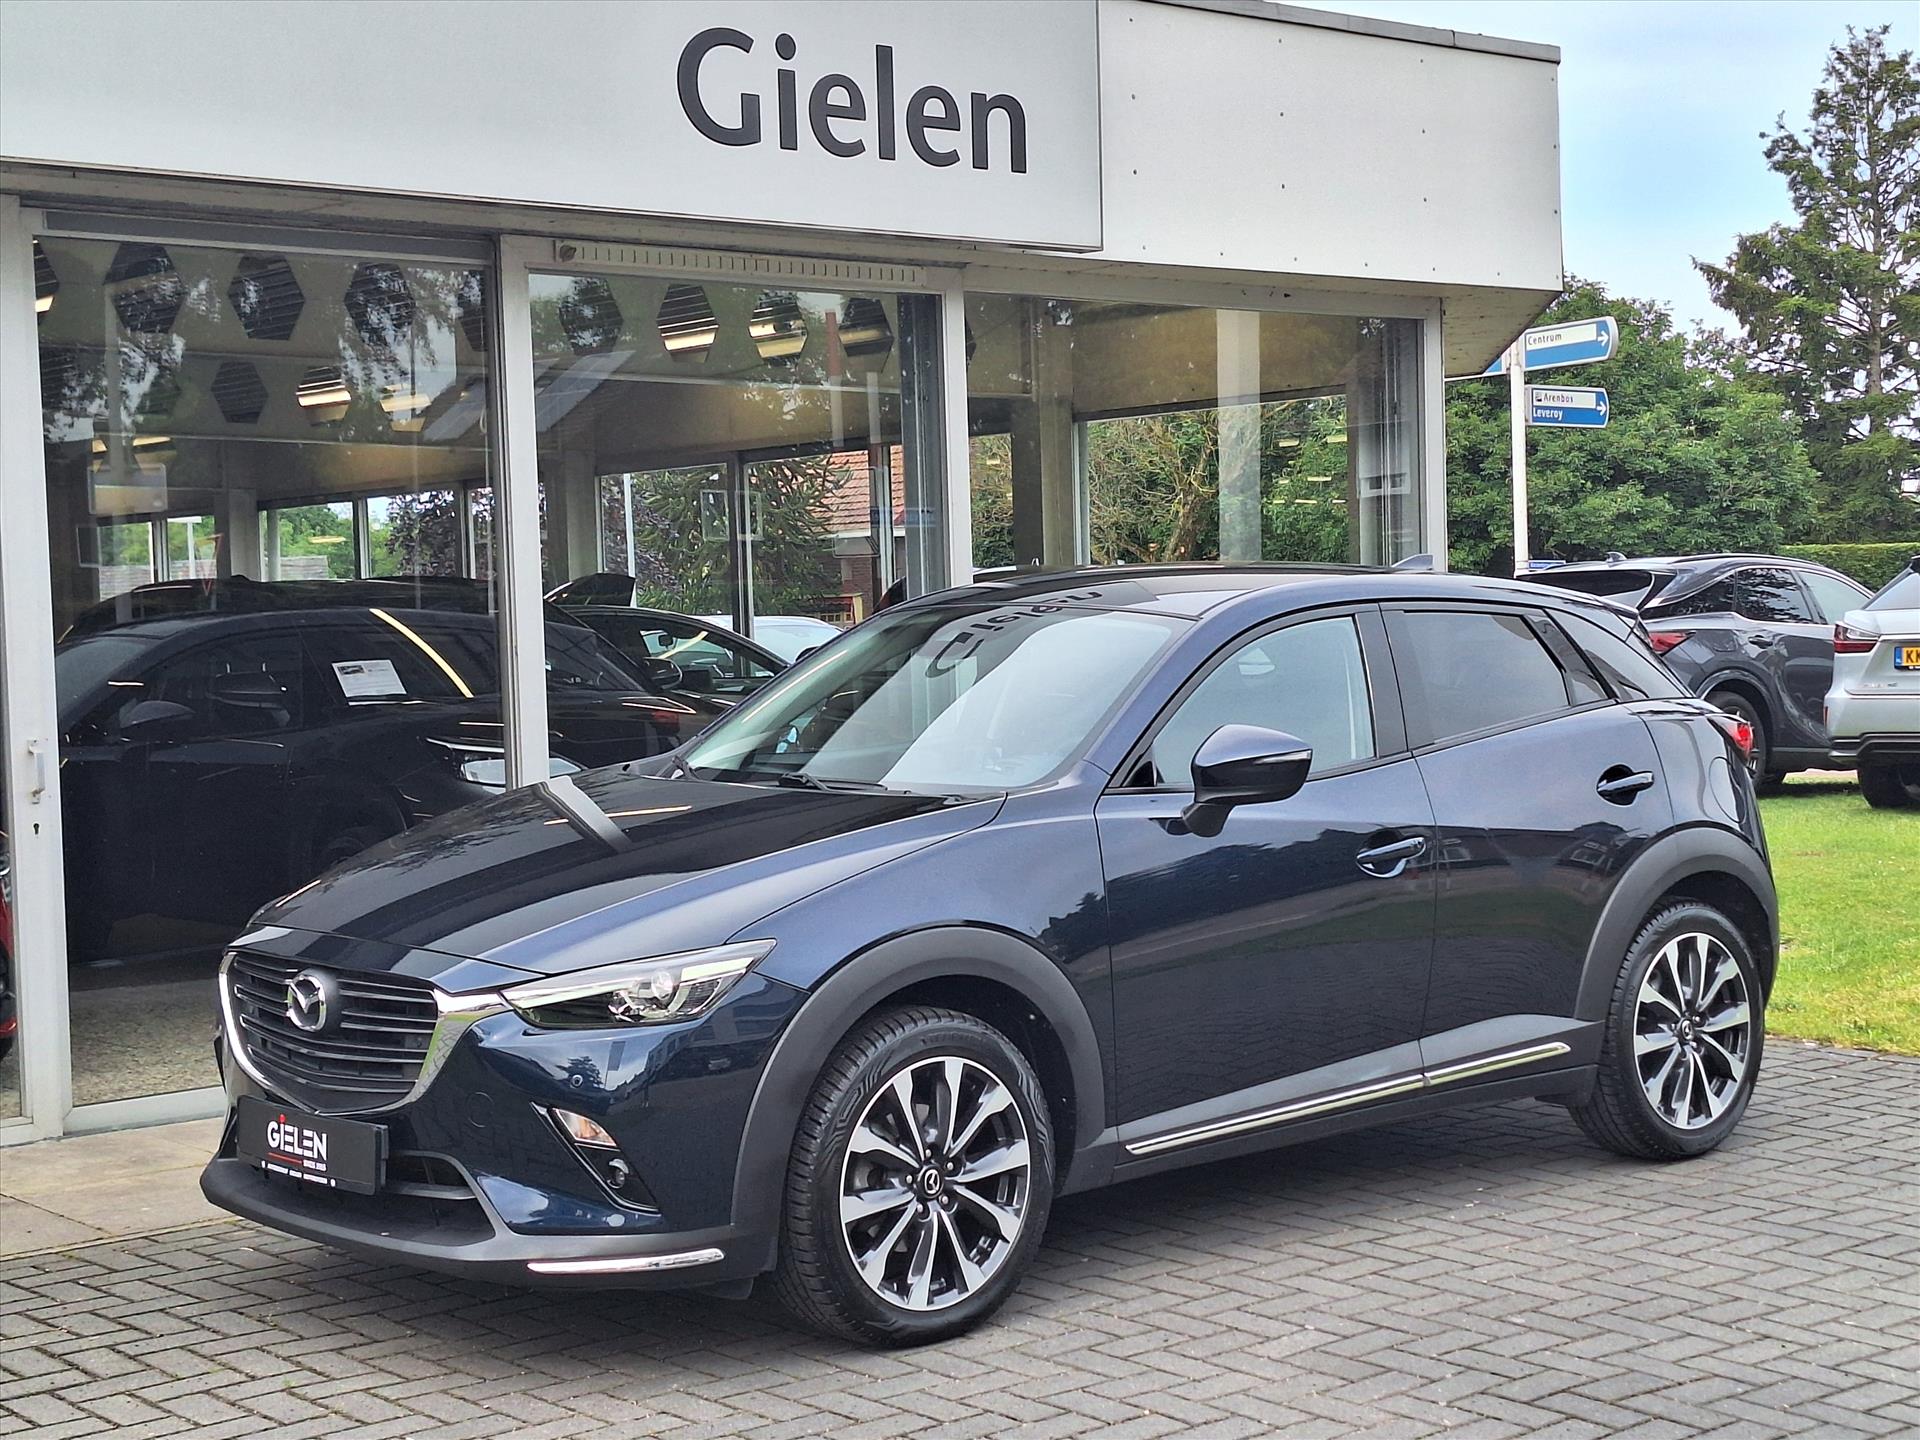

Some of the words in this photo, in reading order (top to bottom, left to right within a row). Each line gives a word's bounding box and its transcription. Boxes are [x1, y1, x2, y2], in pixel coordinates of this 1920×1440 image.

[676, 27, 1027, 174] Gielen
[1527, 333, 1562, 346] Centrum
[1543, 392, 1574, 403] Arenbos
[1533, 407, 1563, 421] Leveroy
